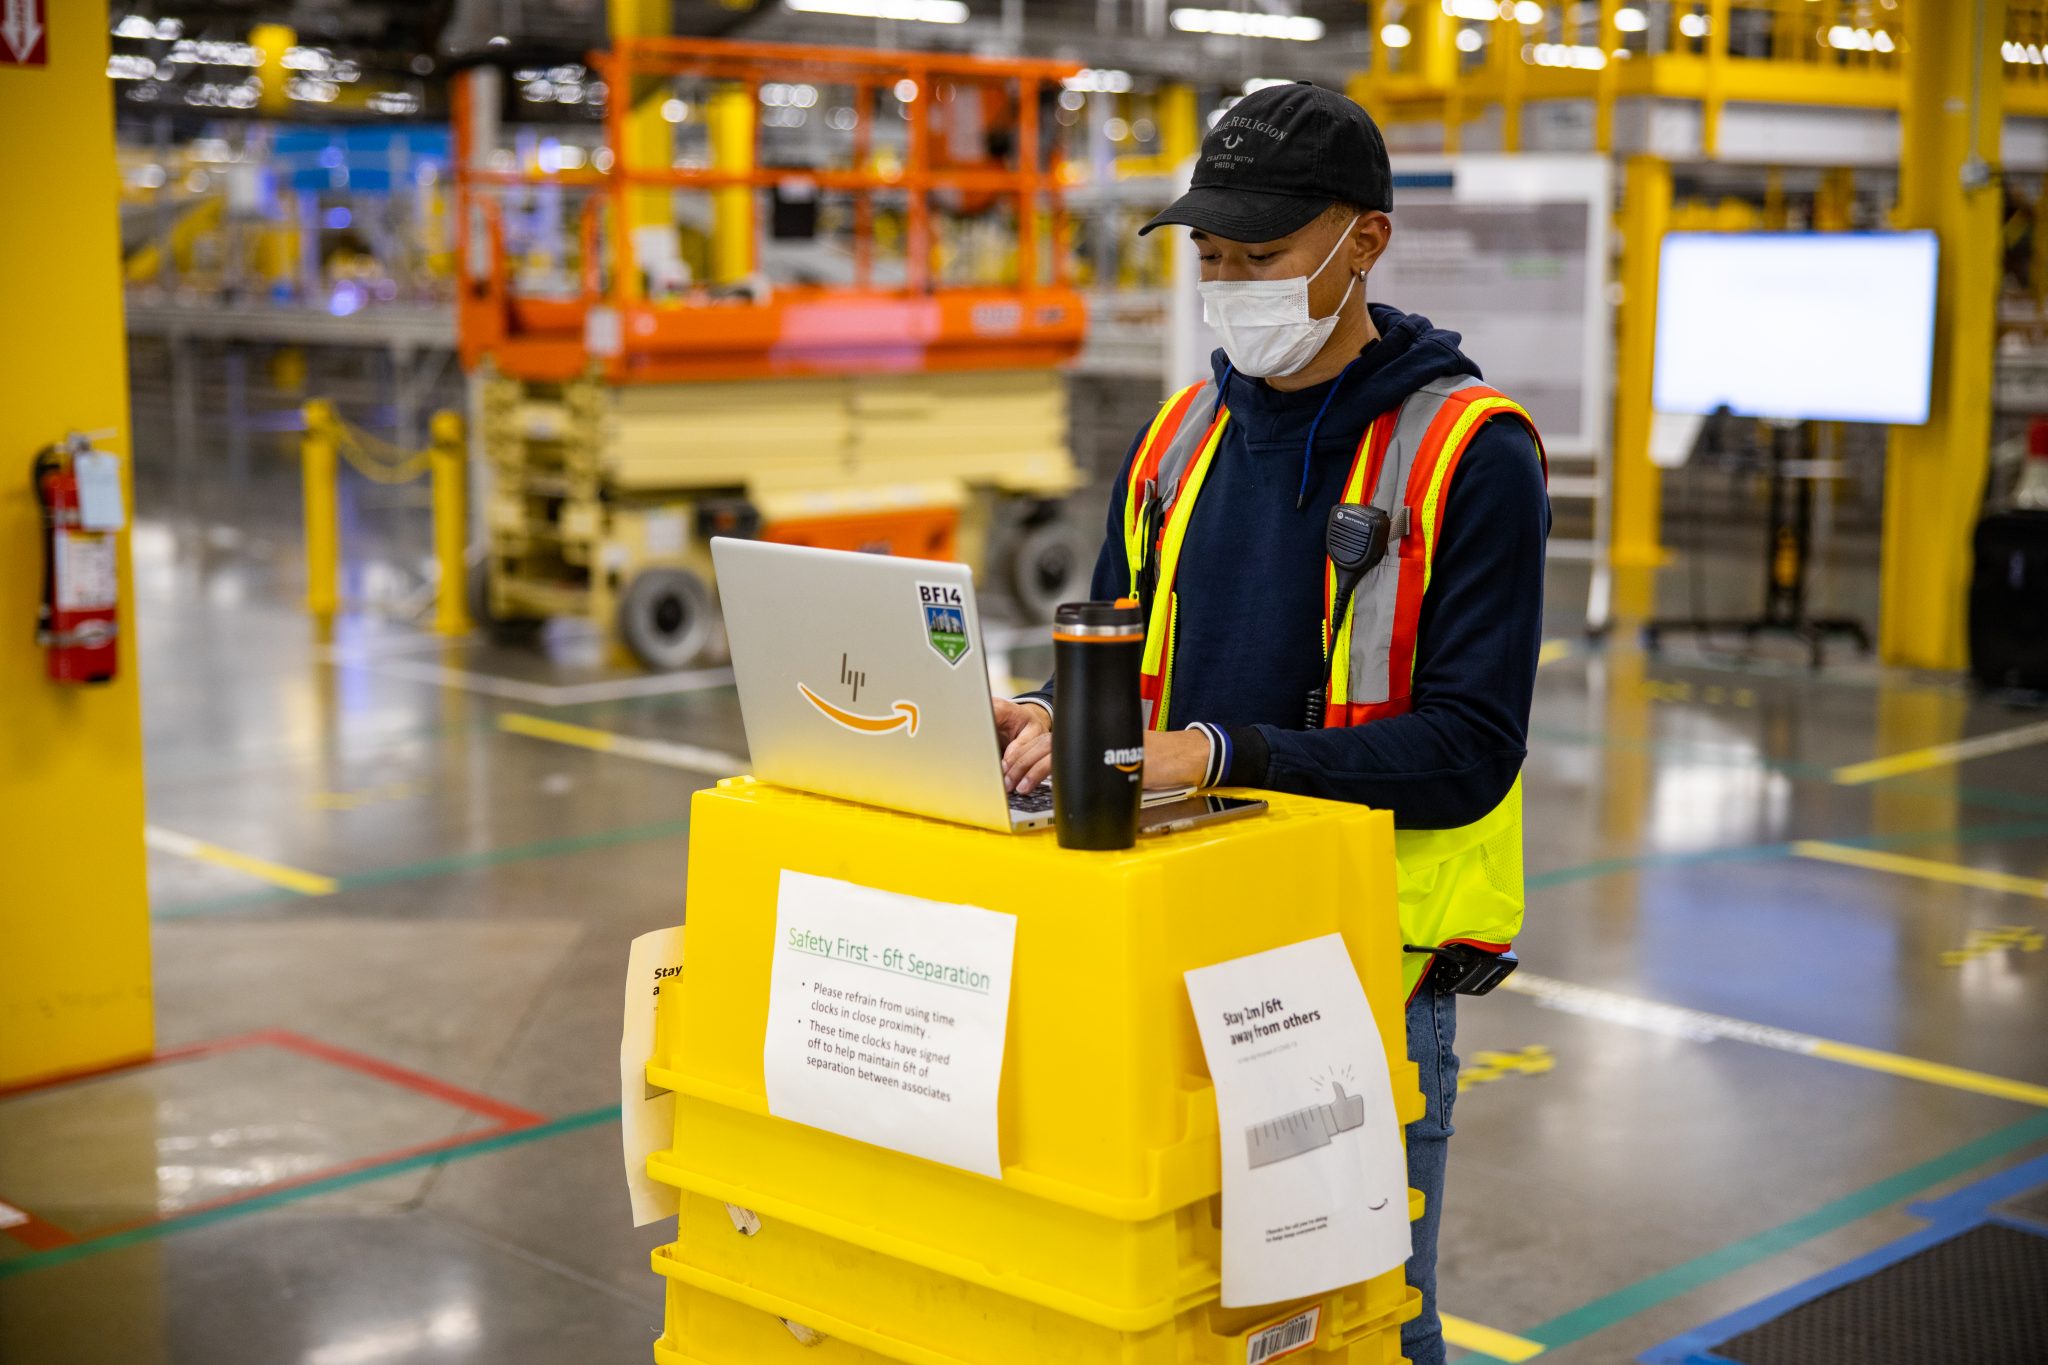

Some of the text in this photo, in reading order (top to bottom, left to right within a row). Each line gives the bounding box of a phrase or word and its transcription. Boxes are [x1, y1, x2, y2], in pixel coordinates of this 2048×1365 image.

[1230, 116, 1289, 141] RELIGION
[1214, 161, 1236, 170] PRIDE
[1234, 154, 1255, 164] WITH
[654, 965, 684, 980] Stay
[788, 927, 833, 958] Safety
[837, 937, 869, 962] First
[883, 948, 904, 971] 6ft
[907, 952, 990, 990] Separation
[811, 1000, 839, 1017] clocks
[841, 1005, 850, 1018] in
[852, 1009, 877, 1025] close
[814, 982, 955, 1027] Please refrain from using time
[1222, 998, 1284, 1026] Stay 2m/6ft
[809, 1019, 951, 1066] These time clocks have signed
[1230, 1010, 1321, 1045] away from others
[807, 1037, 929, 1078] off to help maintain 6ft of
[806, 1054, 951, 1103] separation between associates
